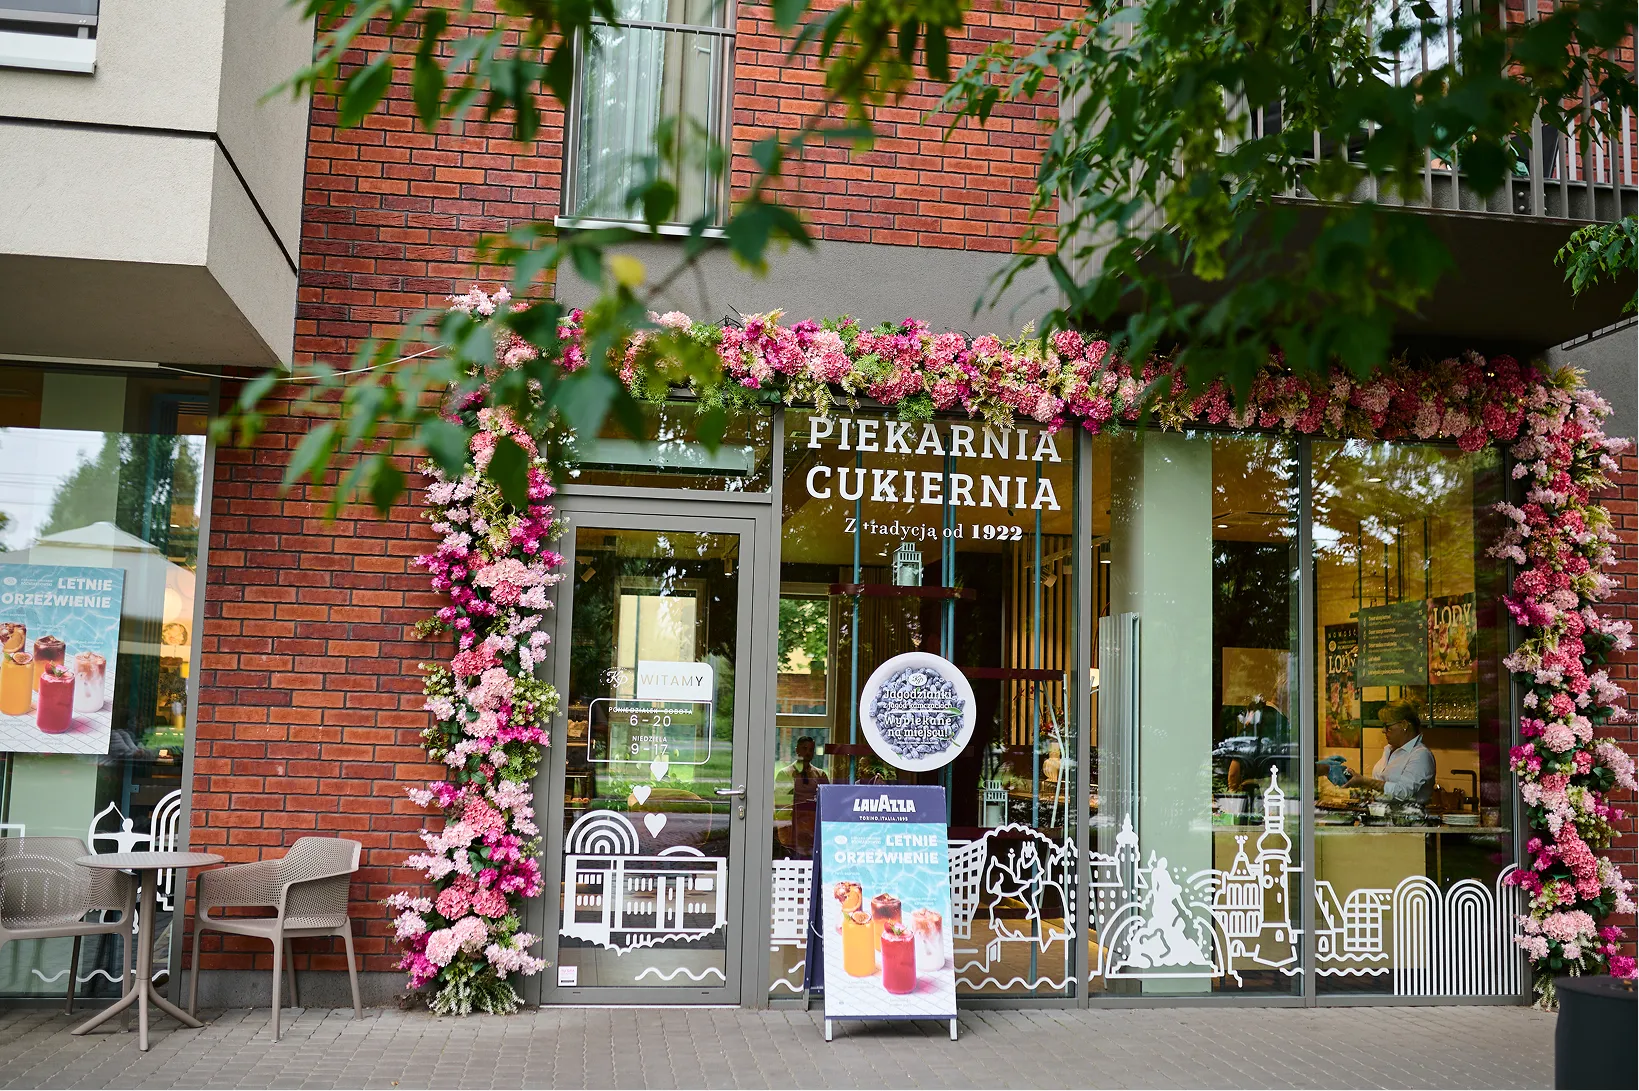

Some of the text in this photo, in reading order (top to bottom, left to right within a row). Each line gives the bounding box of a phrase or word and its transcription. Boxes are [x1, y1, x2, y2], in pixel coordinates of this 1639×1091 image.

[807, 416, 1062, 463] PIEKARNIA
[806, 465, 1061, 511] CUKIERNIA
[844, 517, 1023, 542] Z tradycją od 1922
[57, 577, 113, 591] LETNIE
[1433, 603, 1472, 629] LODY
[640, 674, 704, 687] WITAMY
[883, 689, 953, 701] Jagodzianki
[883, 715, 952, 727] Wypiekane
[632, 735, 668, 743] NIEDZIELA
[887, 728, 948, 739] na miejscu!
[853, 794, 916, 813] LAVAZZA
[886, 834, 938, 847] LETNIE
